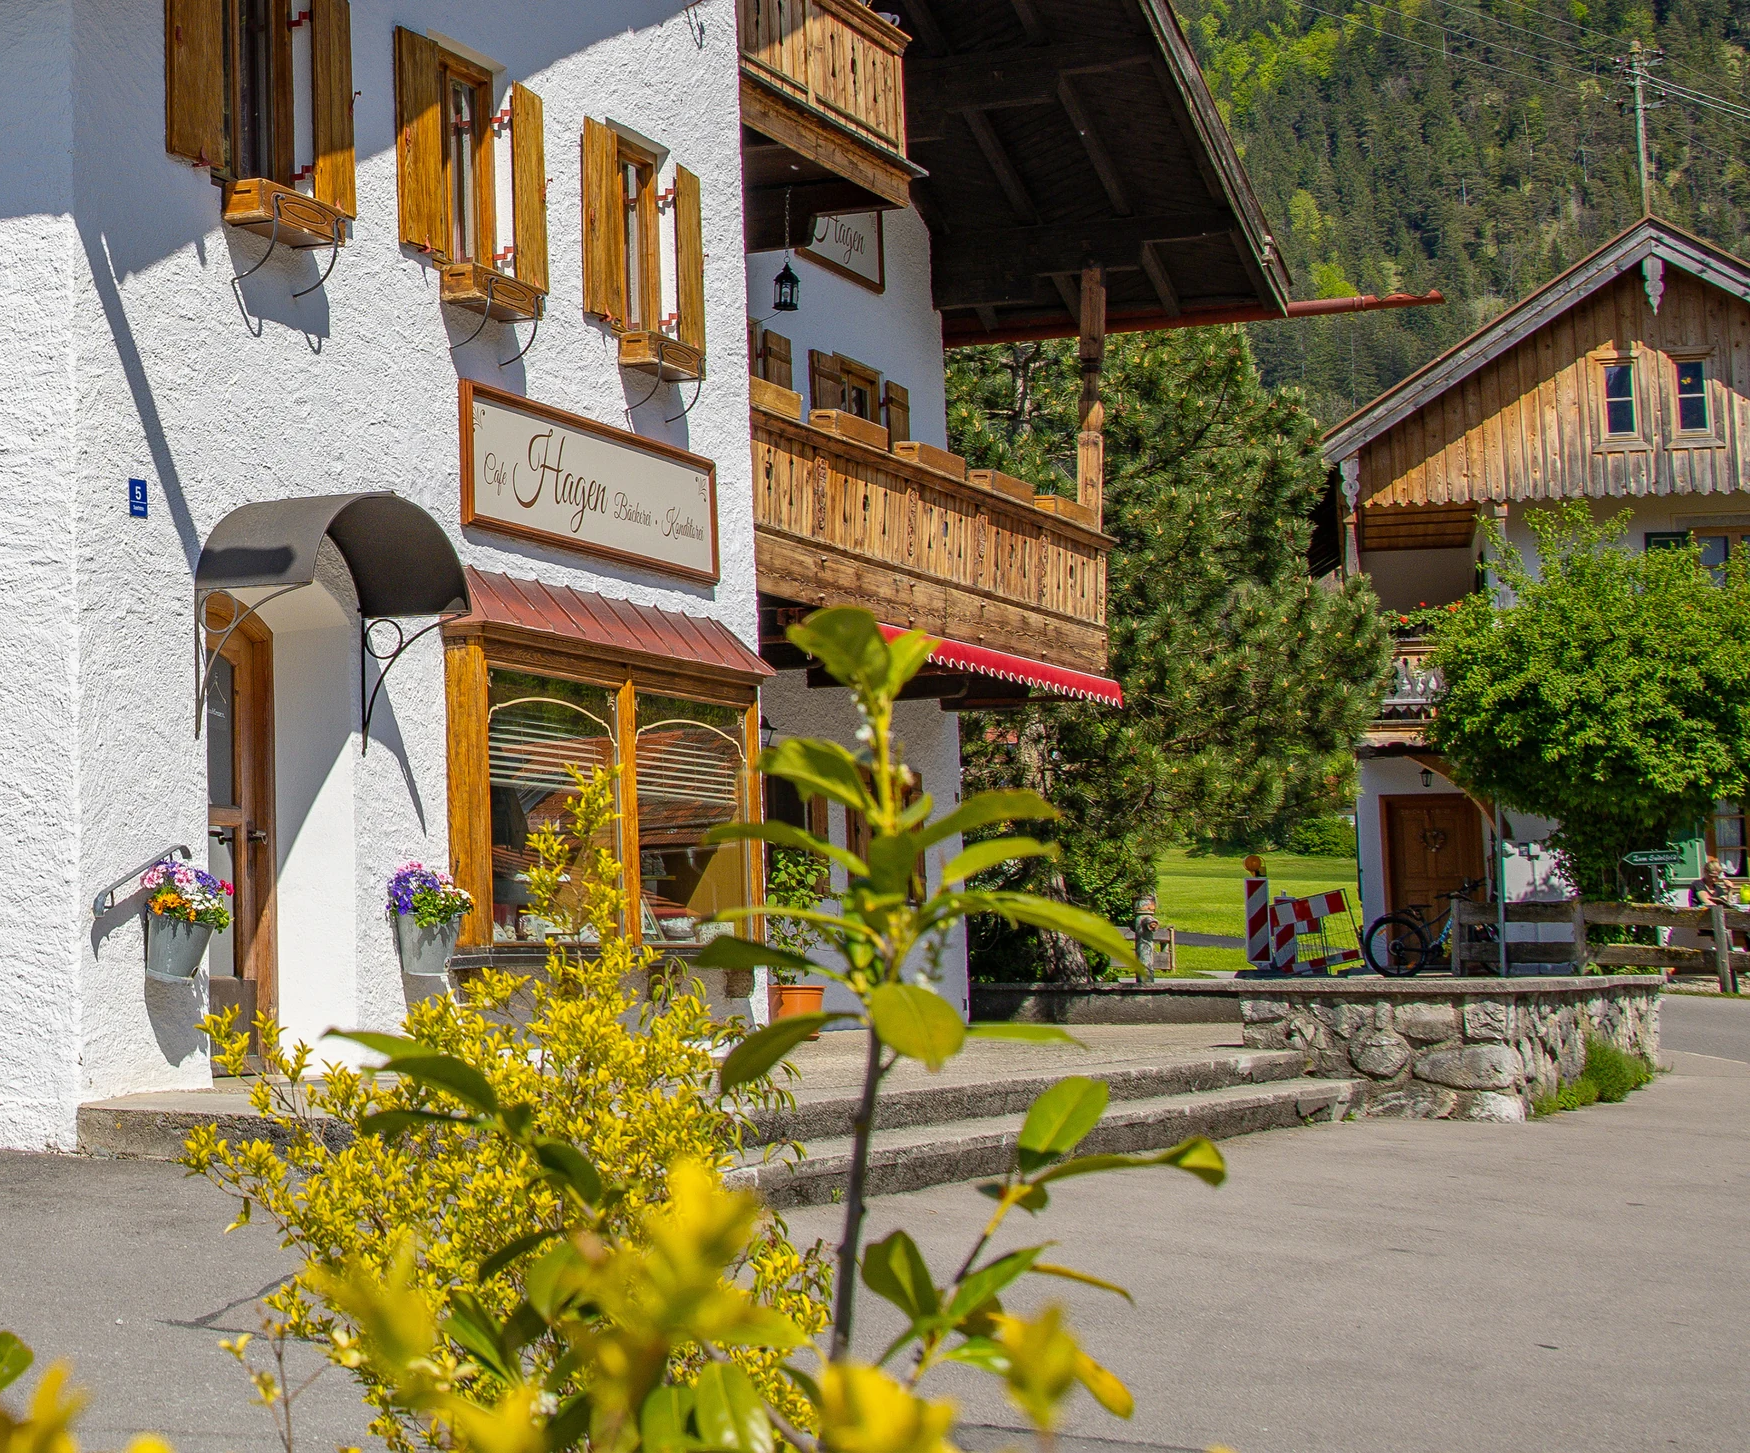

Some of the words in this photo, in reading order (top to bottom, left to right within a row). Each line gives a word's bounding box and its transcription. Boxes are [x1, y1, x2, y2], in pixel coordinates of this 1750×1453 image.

[135, 486, 142, 500] 5
[484, 451, 507, 496] Cafe
[512, 428, 609, 533] Hagen
[613, 491, 652, 527] Bäckerei
[661, 506, 704, 541] Konditorei
